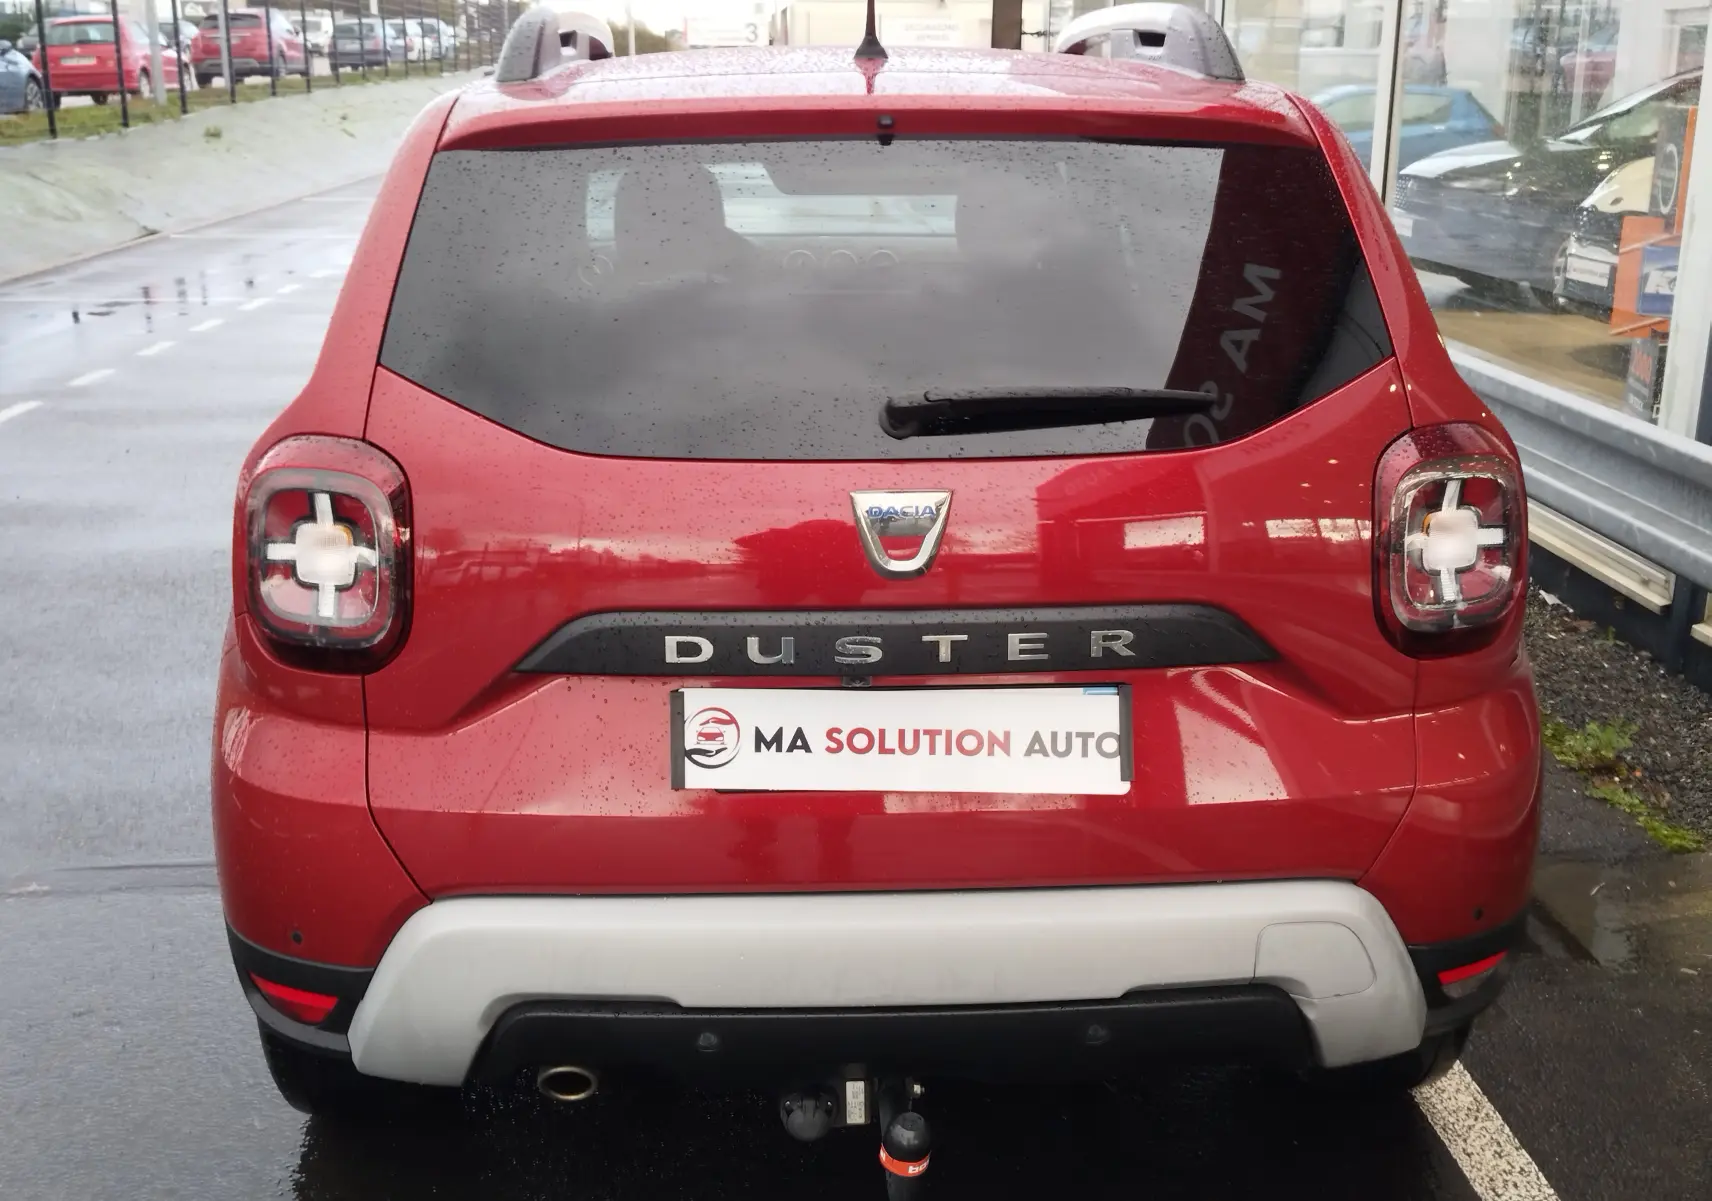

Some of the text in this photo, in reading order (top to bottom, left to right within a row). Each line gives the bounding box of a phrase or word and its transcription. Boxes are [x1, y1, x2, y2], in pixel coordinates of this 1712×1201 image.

[744, 22, 758, 43] 3
[867, 506, 935, 519] DACIA
[665, 630, 1136, 664] DUSTER
[754, 726, 1120, 759] MA SOLUTION AUTO
